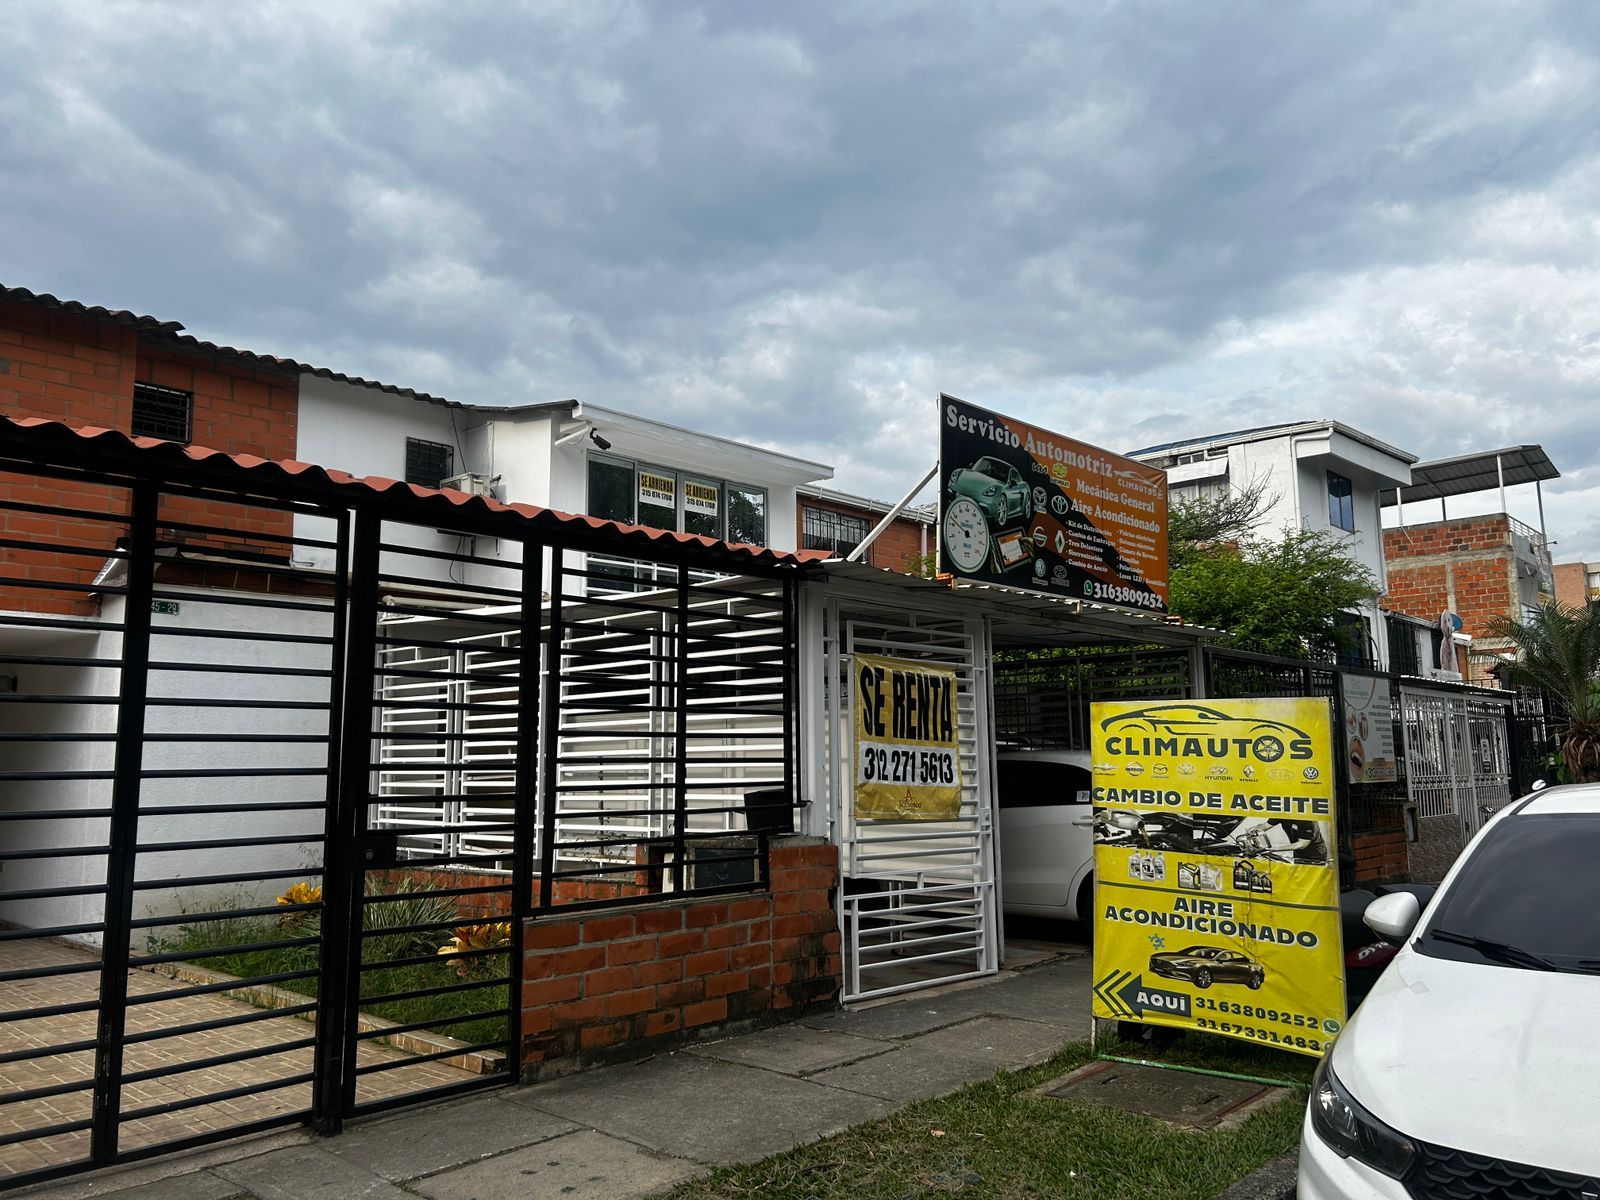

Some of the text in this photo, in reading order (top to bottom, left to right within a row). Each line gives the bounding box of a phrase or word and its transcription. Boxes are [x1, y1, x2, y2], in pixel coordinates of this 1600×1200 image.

[946, 405, 1115, 478] Servicio Automotriz
[641, 474, 674, 494] SE ARRIENDA
[642, 489, 651, 497] 315
[685, 483, 717, 501] SE ARRIENDA
[1076, 478, 1155, 513] Mecánica General
[686, 497, 696, 505] 315
[1071, 498, 1093, 515] Aire
[1094, 504, 1160, 533] Acondicionado
[1068, 529, 1087, 540] Cambio
[1068, 539, 1104, 553] Tren Delantero
[1068, 558, 1087, 569] Cambio
[1132, 575, 1143, 583] LED
[1093, 582, 1163, 609] 3163809252
[859, 665, 953, 743] SE RENTA
[1105, 735, 1314, 763] CLIMAUTOS
[864, 748, 954, 784] 312 271 5613
[1092, 786, 1330, 815] CAMBIO DE ACEITE
[1173, 896, 1233, 918] AIRE
[1104, 905, 1319, 948] ACONDICIONADO
[1195, 997, 1319, 1030] 3163809252
[1196, 1017, 1321, 1051] 3167331483
